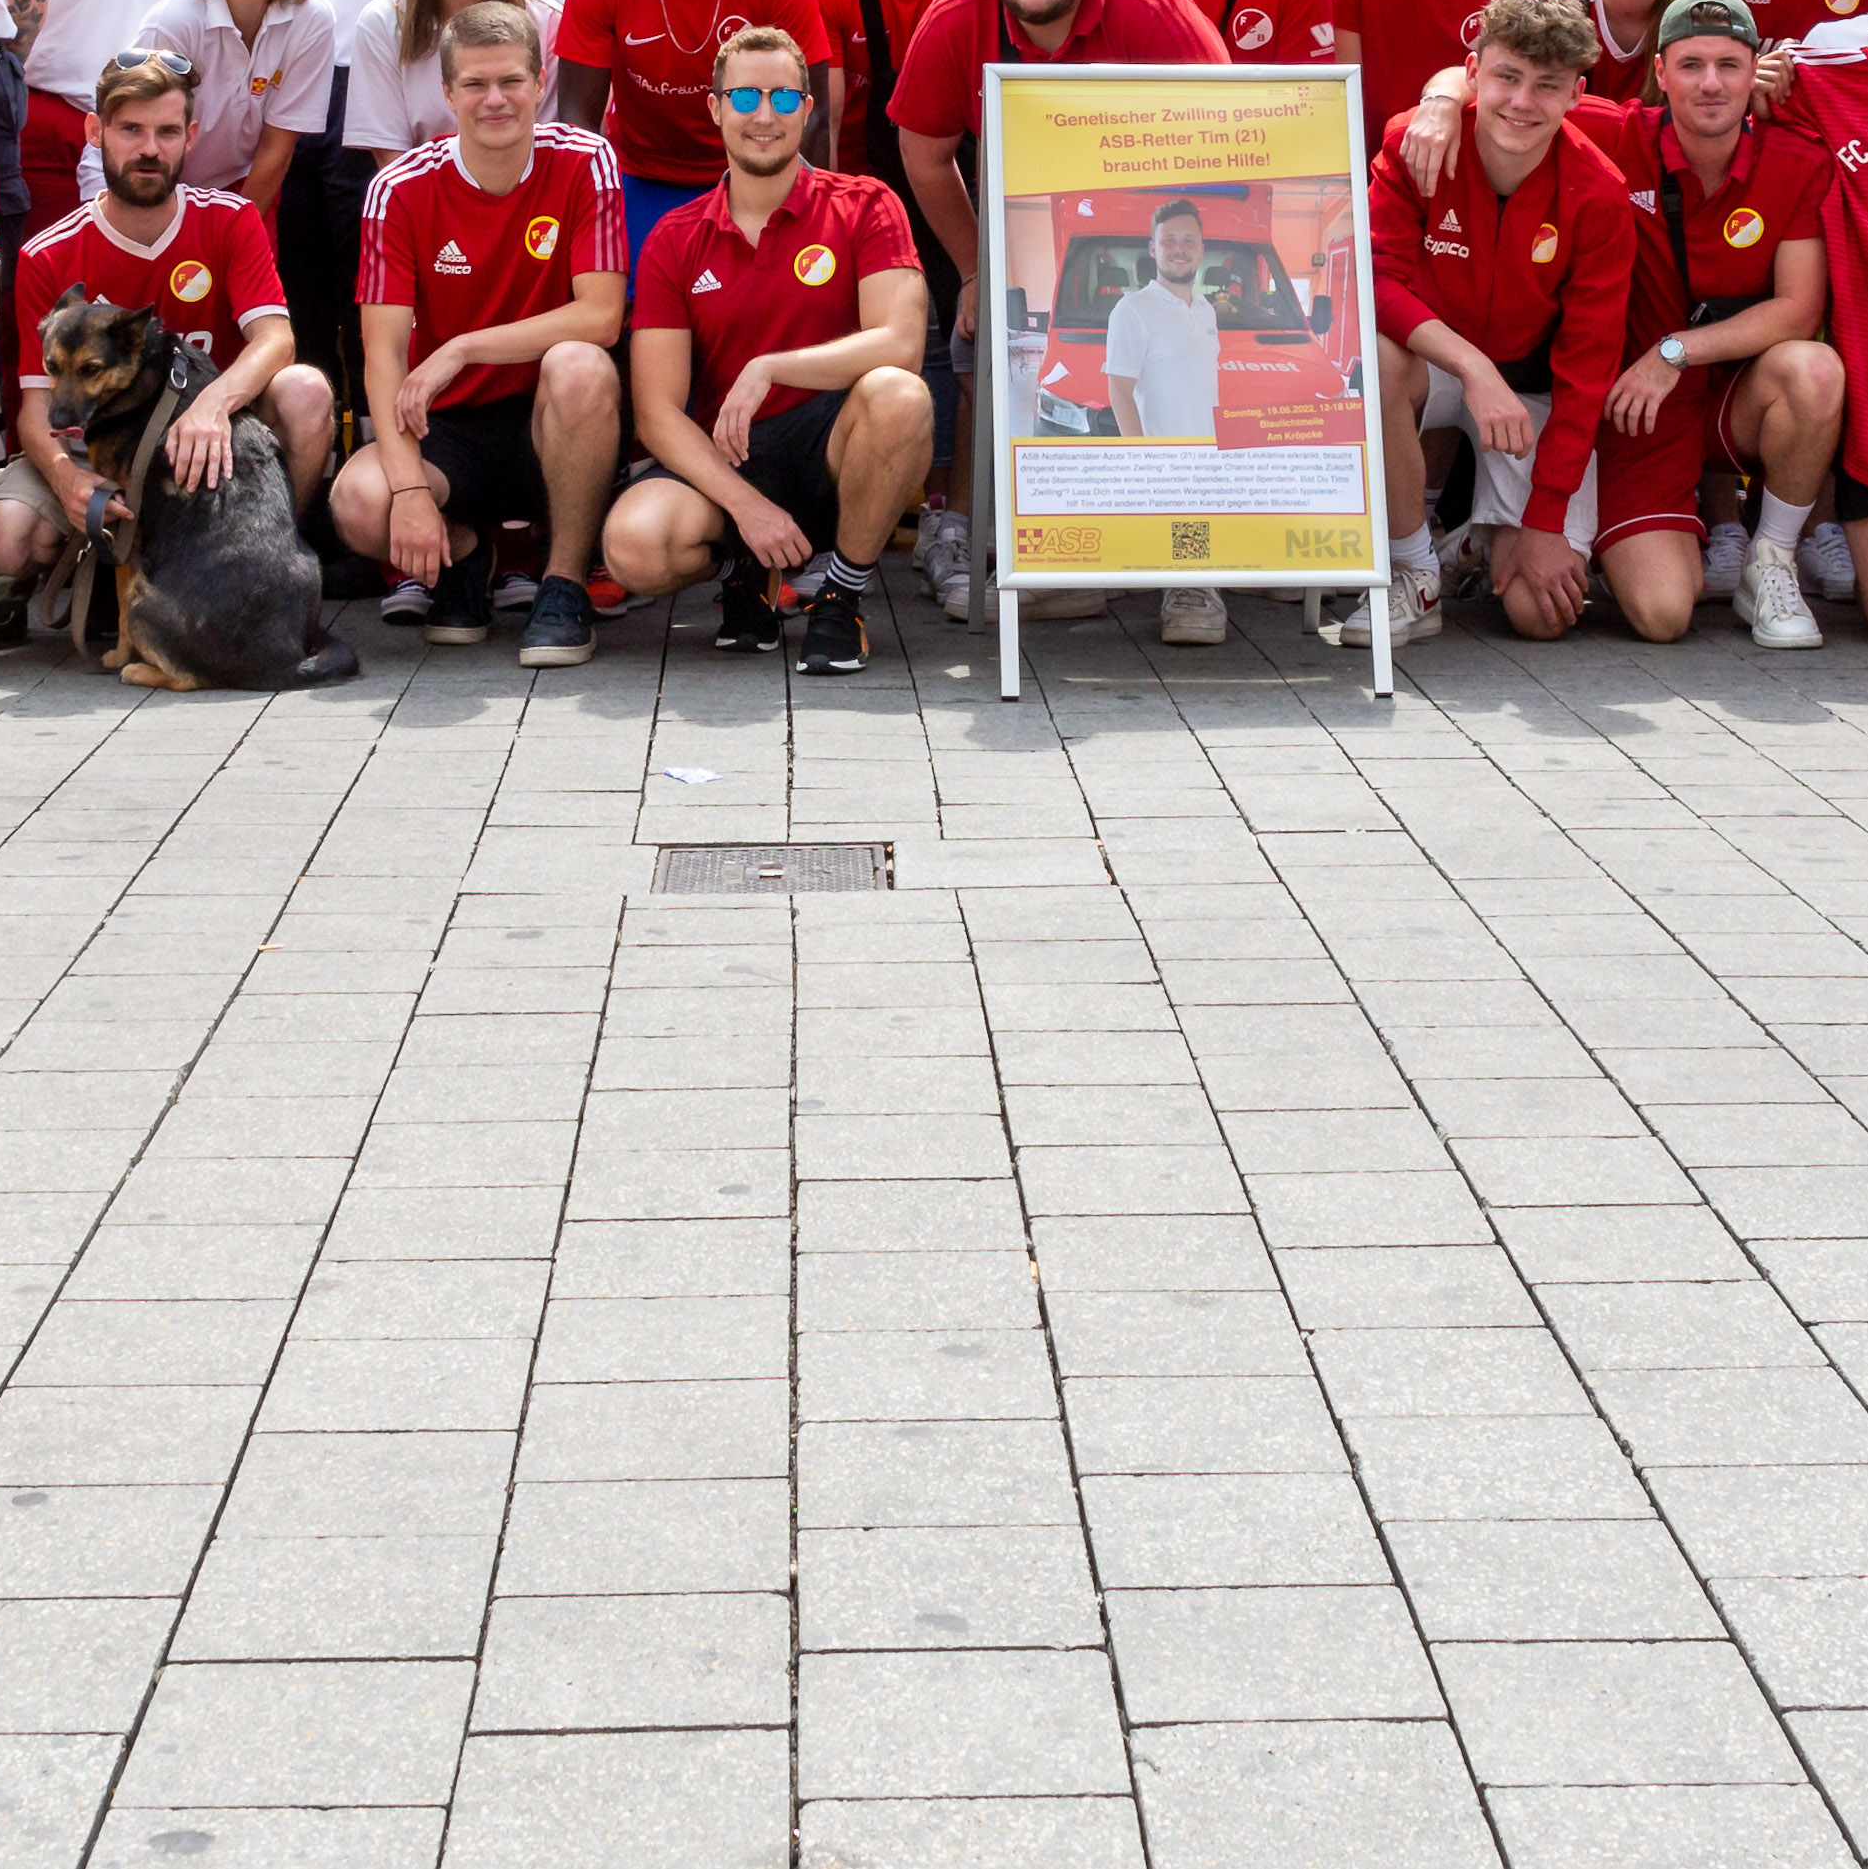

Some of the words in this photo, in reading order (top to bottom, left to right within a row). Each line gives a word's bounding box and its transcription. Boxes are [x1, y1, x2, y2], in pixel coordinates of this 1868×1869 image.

[1045, 109, 1158, 128] "Genetischer
[1162, 105, 1228, 124] Zwilling
[1232, 102, 1315, 122] gesucht":
[1098, 132, 1193, 150] ASB-Retter
[1198, 130, 1230, 145] Tim
[1235, 128, 1266, 147] (21)
[1103, 158, 1169, 174] braucht
[1173, 155, 1222, 170] Deine
[1226, 153, 1271, 168] Hilfe!
[1422, 234, 1471, 259] tipico
[433, 260, 472, 275] tipico
[1267, 432, 1282, 442] Am
[1039, 526, 1102, 556] ASB
[1285, 528, 1364, 560] NKR
